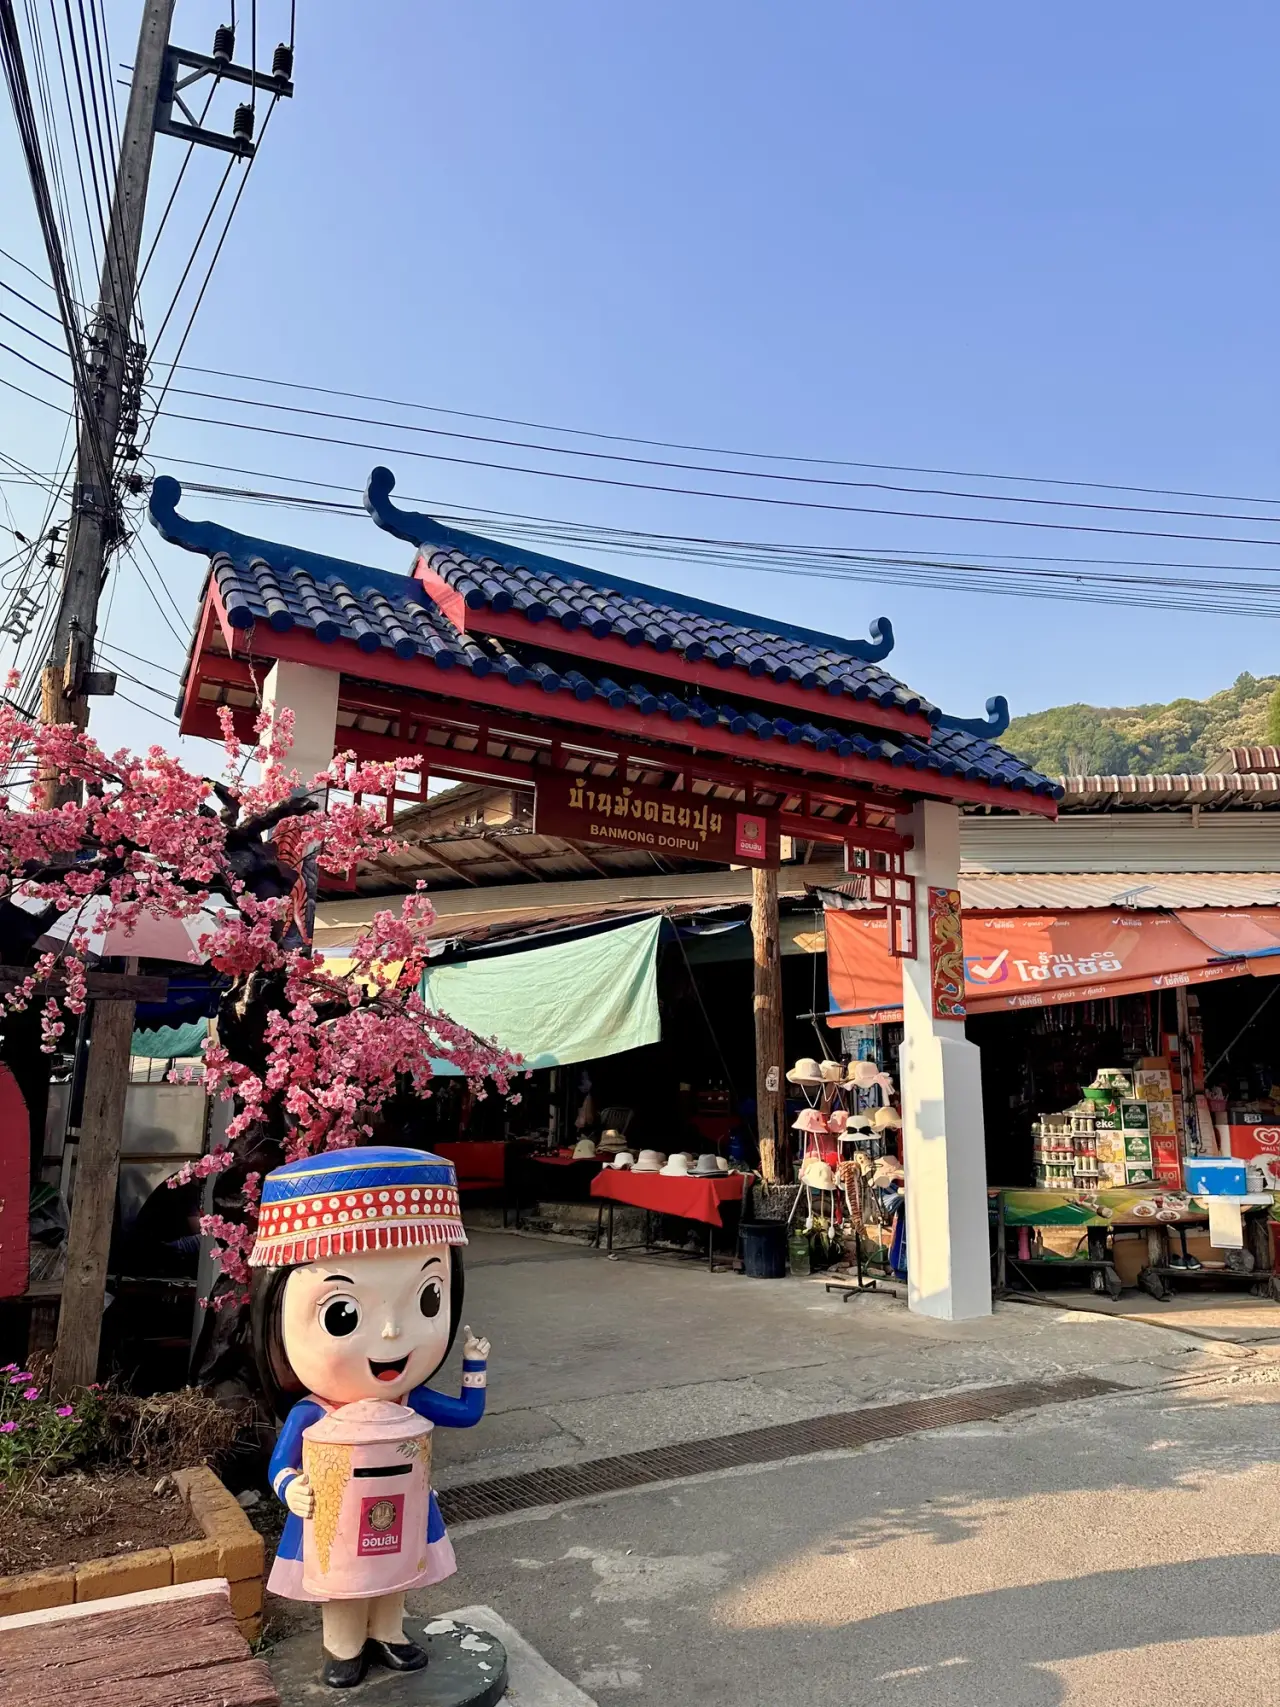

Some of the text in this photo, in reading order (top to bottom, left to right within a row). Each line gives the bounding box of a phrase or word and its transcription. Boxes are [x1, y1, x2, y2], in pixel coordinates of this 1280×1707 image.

[568, 778, 722, 842] บ้านม้งดอยปุย
[590, 824, 699, 851] BANMONG DOIPUI
[1038, 951, 1073, 964] ร้าน
[1012, 952, 1123, 982] โชคชัย
[1124, 1112, 1146, 1121] Chang
[1128, 1142, 1147, 1152] Chang
[362, 1533, 399, 1547] ออมสิน
